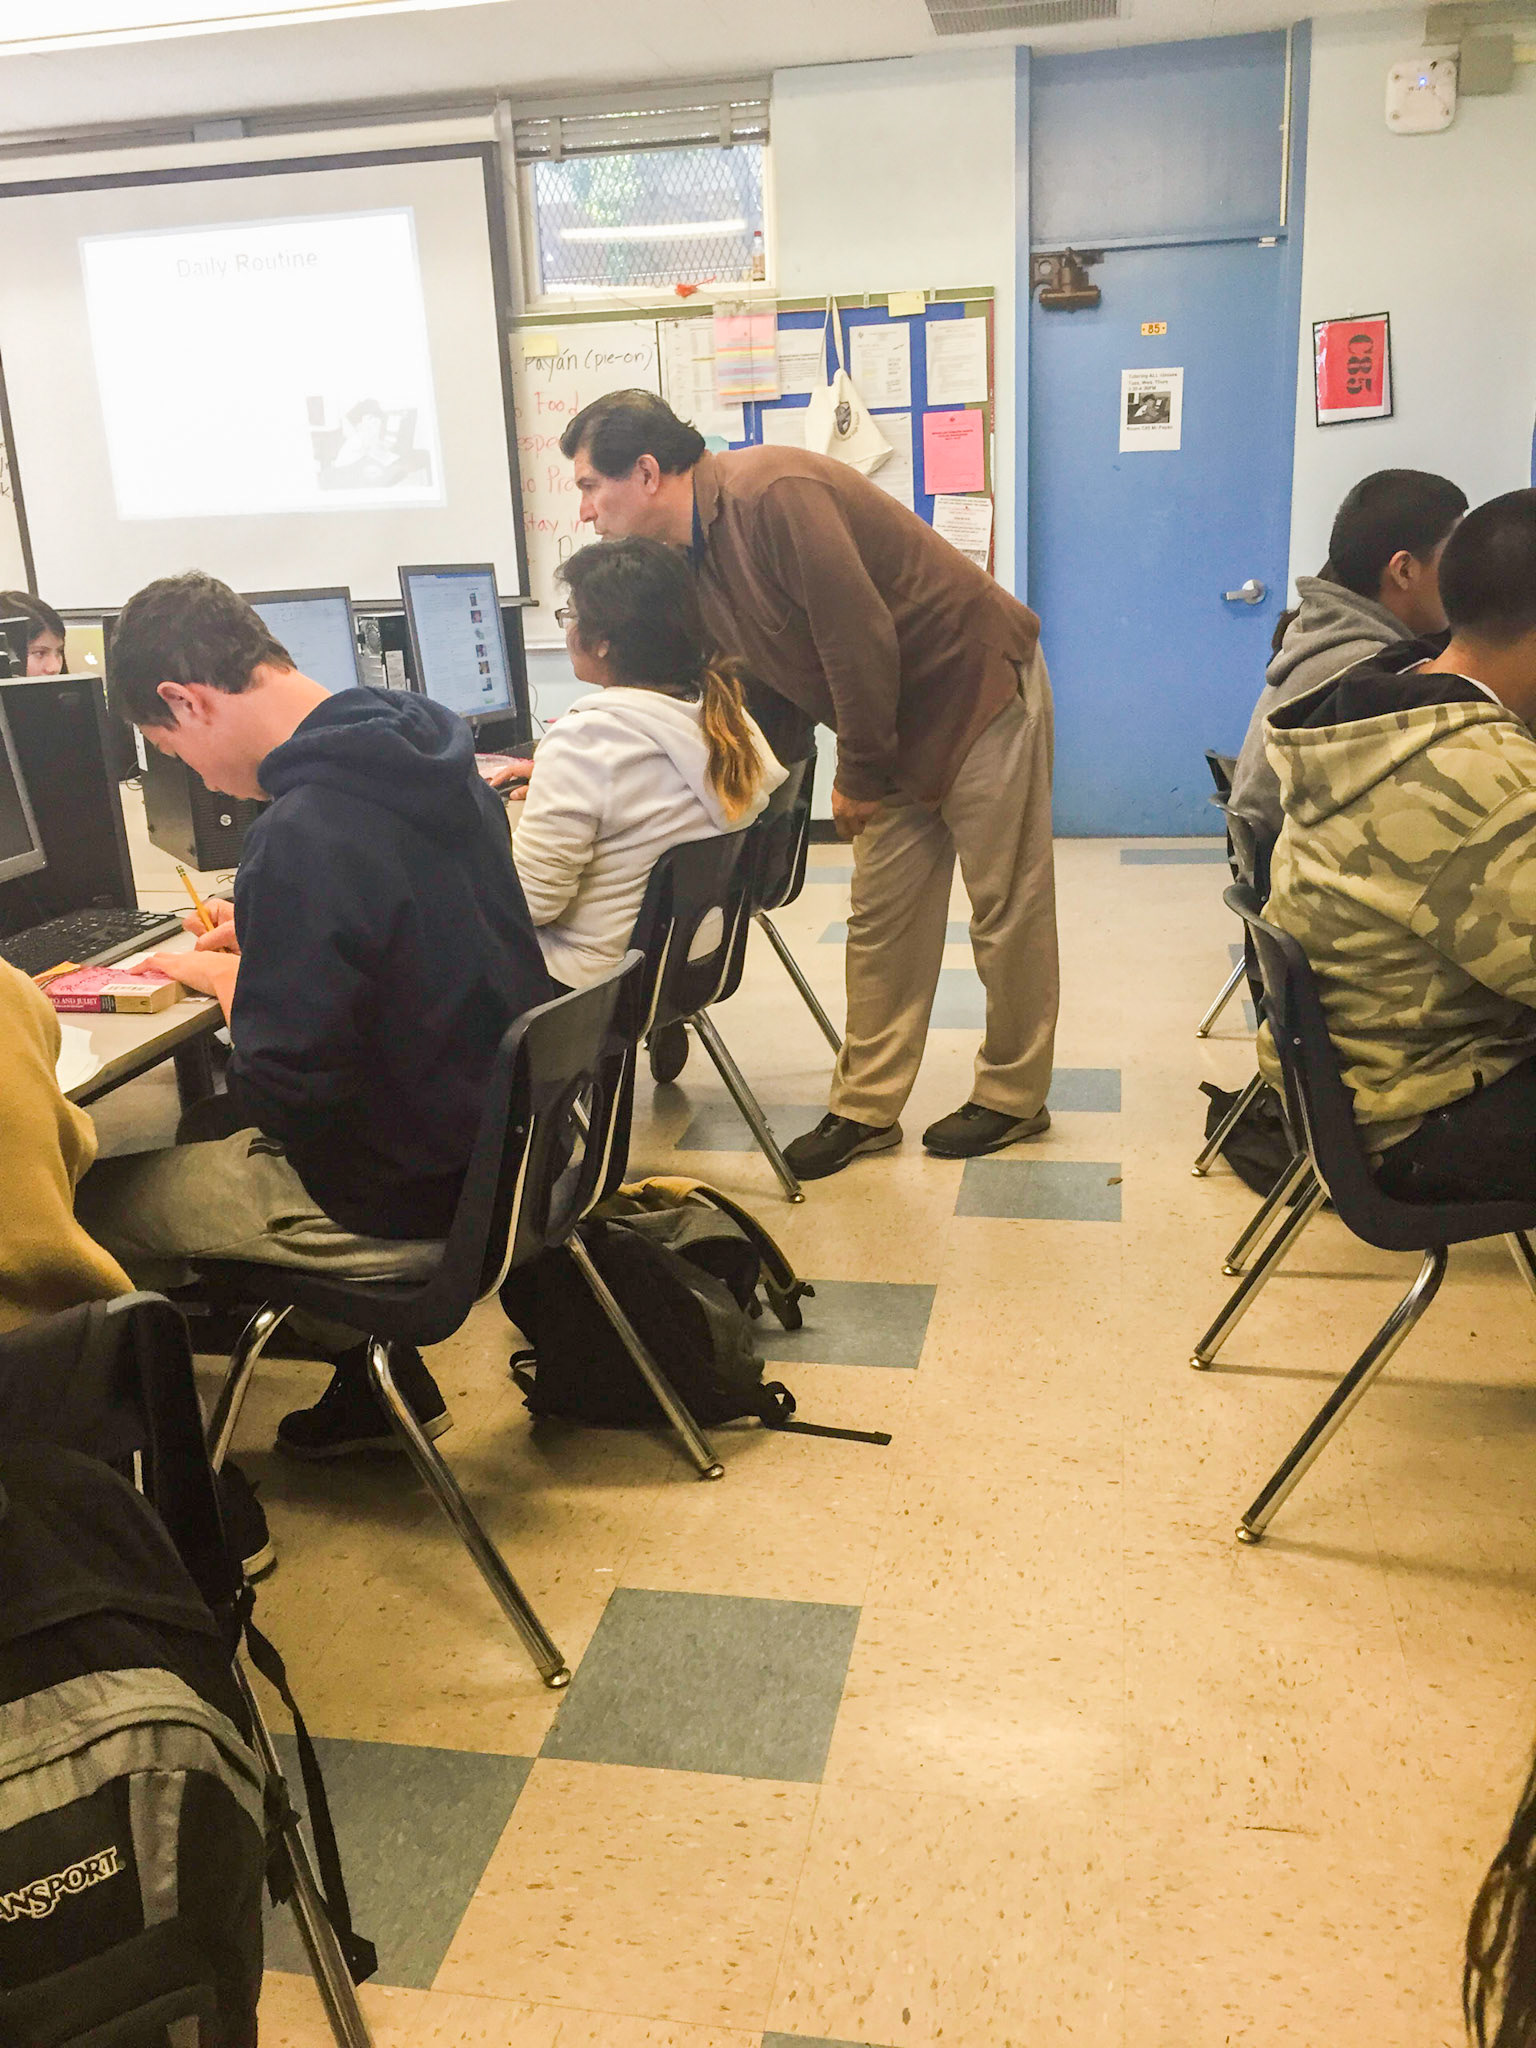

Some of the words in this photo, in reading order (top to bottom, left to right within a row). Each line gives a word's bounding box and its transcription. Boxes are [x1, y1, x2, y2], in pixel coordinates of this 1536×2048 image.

[176, 256, 227, 280] Daily
[235, 249, 318, 273] Routine
[1147, 324, 1160, 334] 85
[1346, 334, 1373, 395] C85
[534, 391, 579, 417] Food
